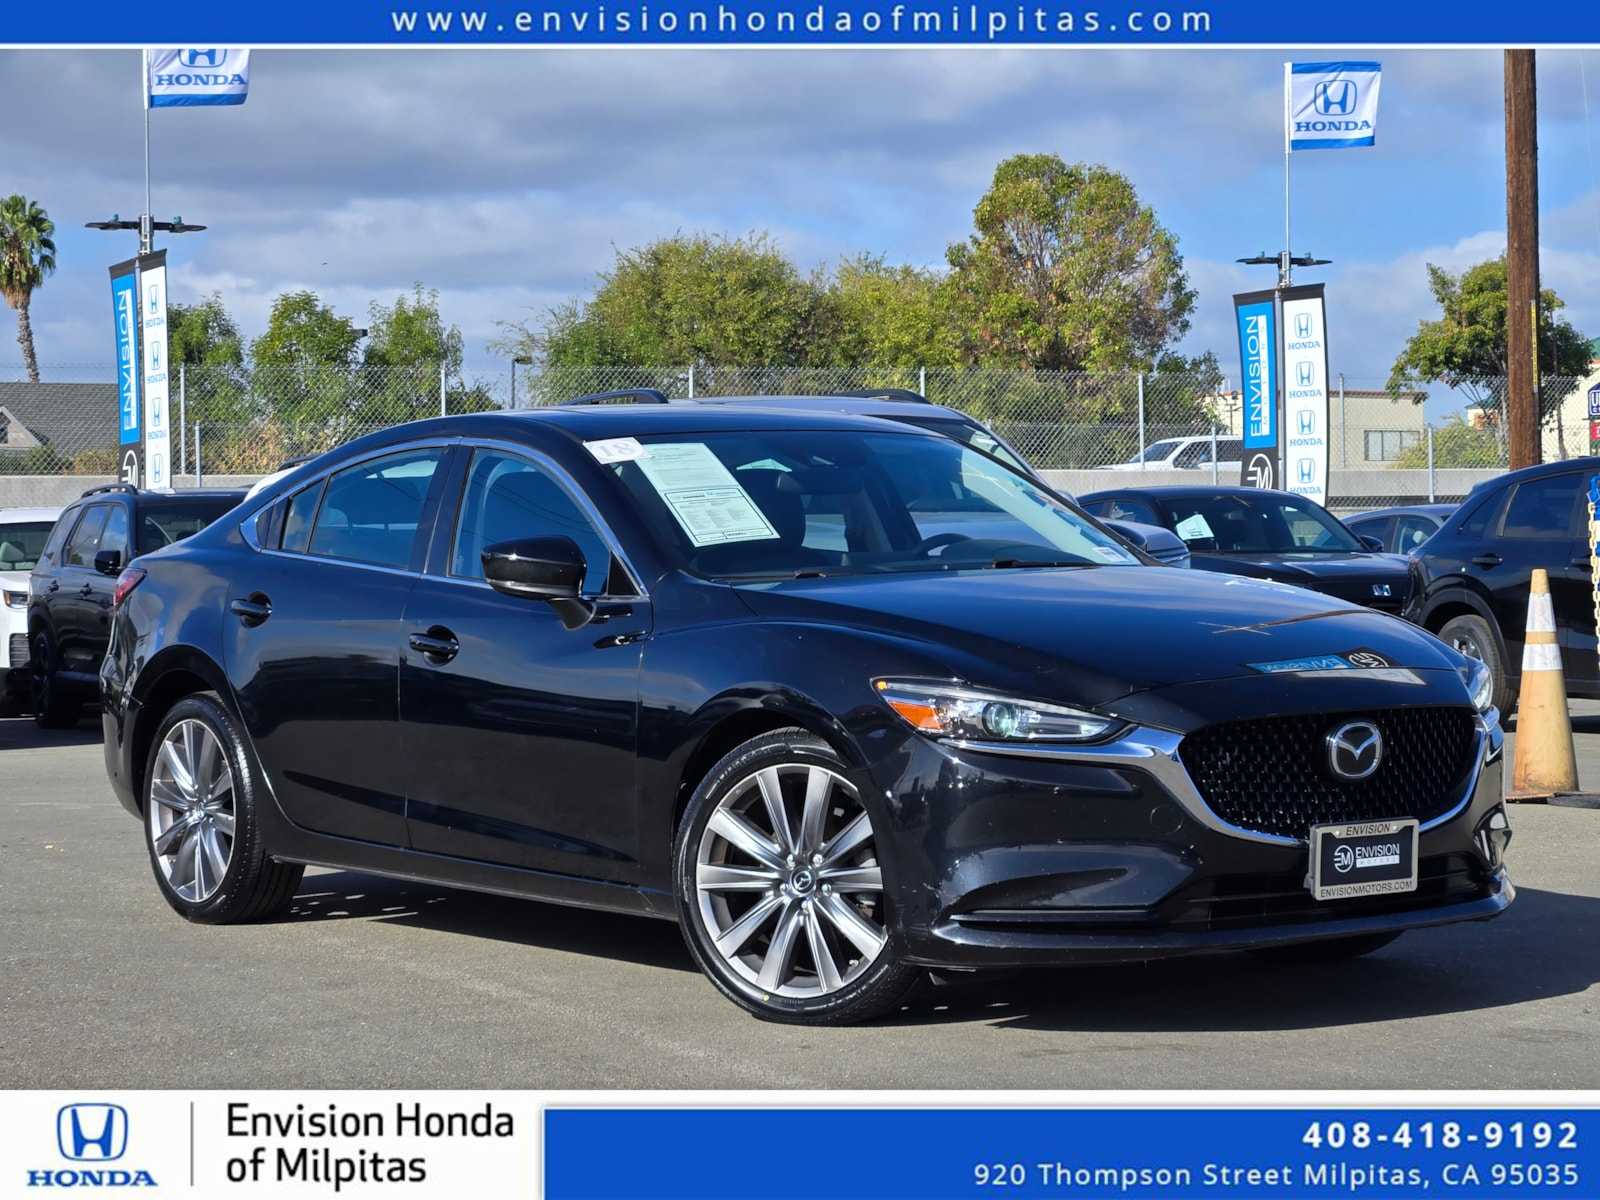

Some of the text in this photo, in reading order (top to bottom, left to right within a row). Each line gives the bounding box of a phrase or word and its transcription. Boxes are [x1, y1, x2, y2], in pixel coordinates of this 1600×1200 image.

[155, 73, 247, 86] HONDA
[1295, 120, 1372, 132] HONDA
[1288, 341, 1321, 351] HONDA
[118, 290, 133, 431] ENVISION
[1245, 315, 1262, 437] ENVISION
[1288, 389, 1322, 398] HONDA
[1289, 438, 1323, 447] HONDA
[1346, 823, 1391, 836] ENVISION
[1355, 843, 1400, 859] ENVISION
[1320, 881, 1413, 898] ENVISIONMOTORS.COM
